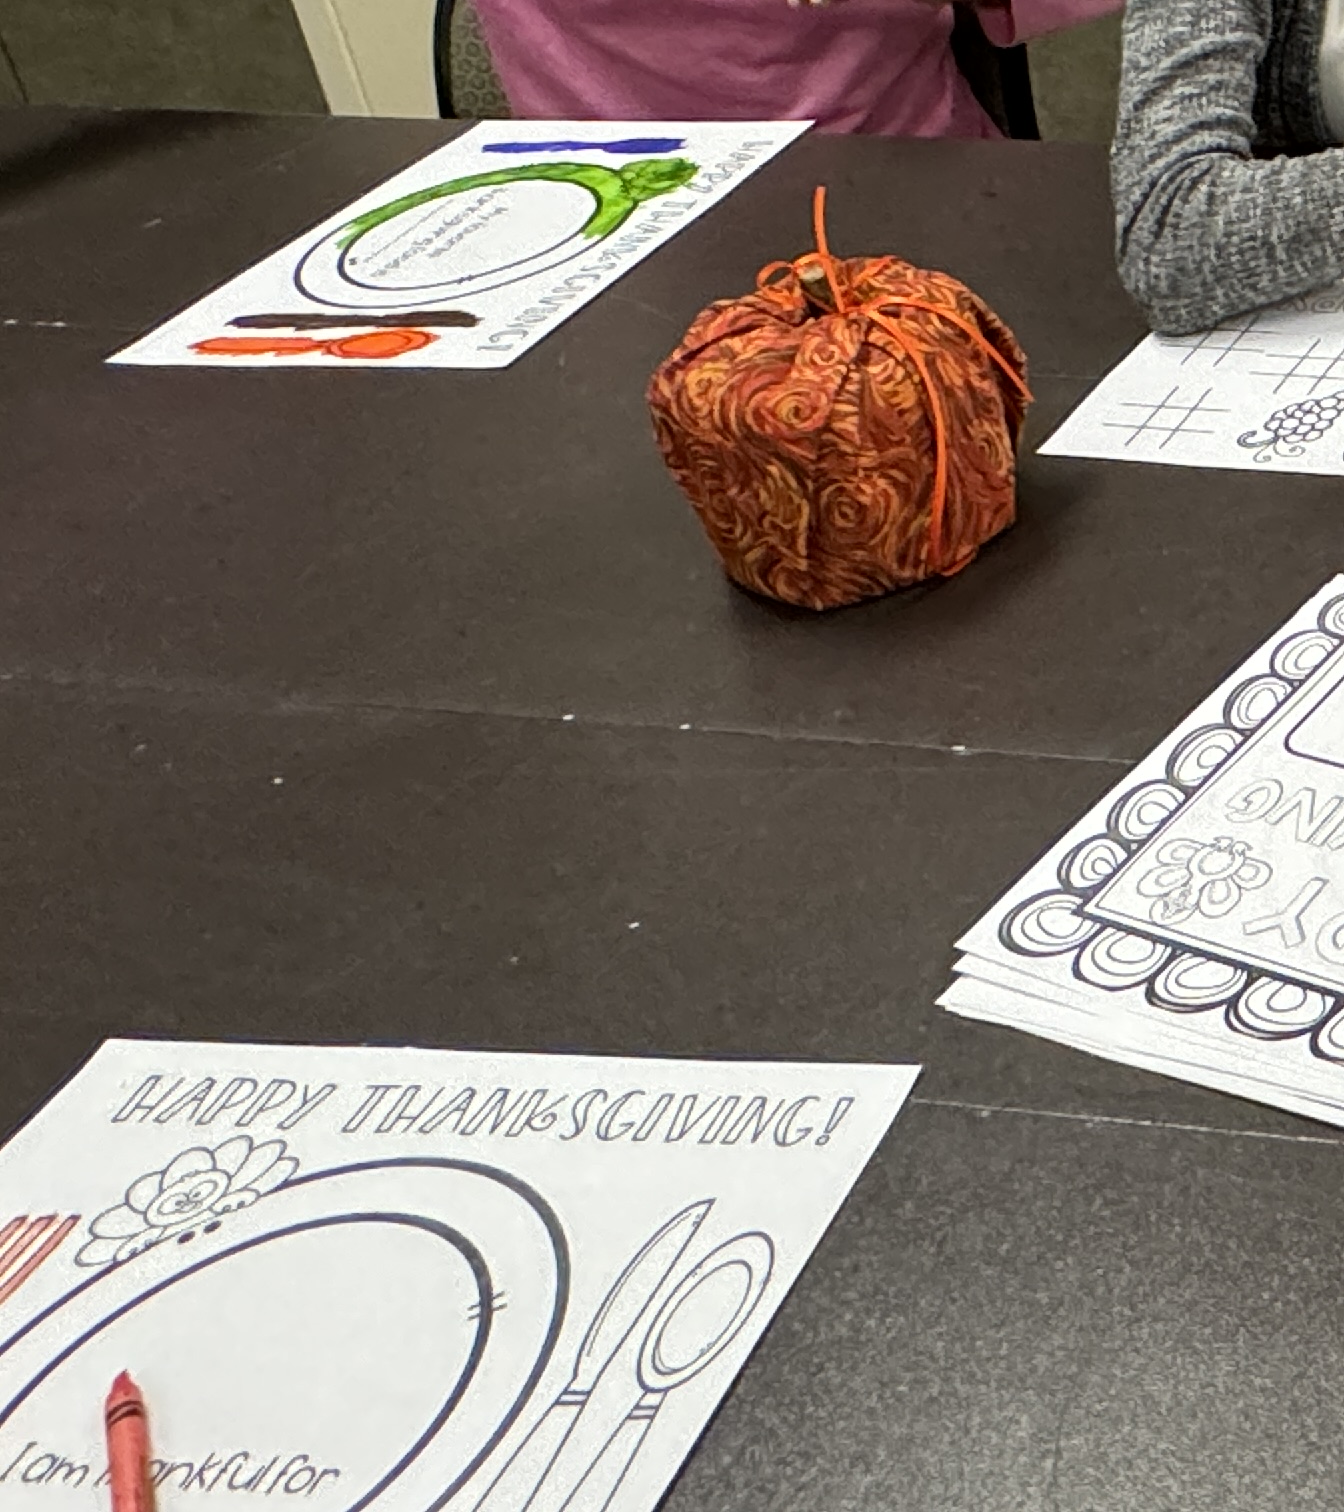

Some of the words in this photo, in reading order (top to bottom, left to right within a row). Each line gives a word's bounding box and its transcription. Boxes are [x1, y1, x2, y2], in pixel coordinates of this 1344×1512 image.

[110, 1074, 339, 1131] HAPPY
[340, 1083, 856, 1149] THANKSGIVING!
[20, 1451, 91, 1489] am
[264, 1453, 342, 1496] for
